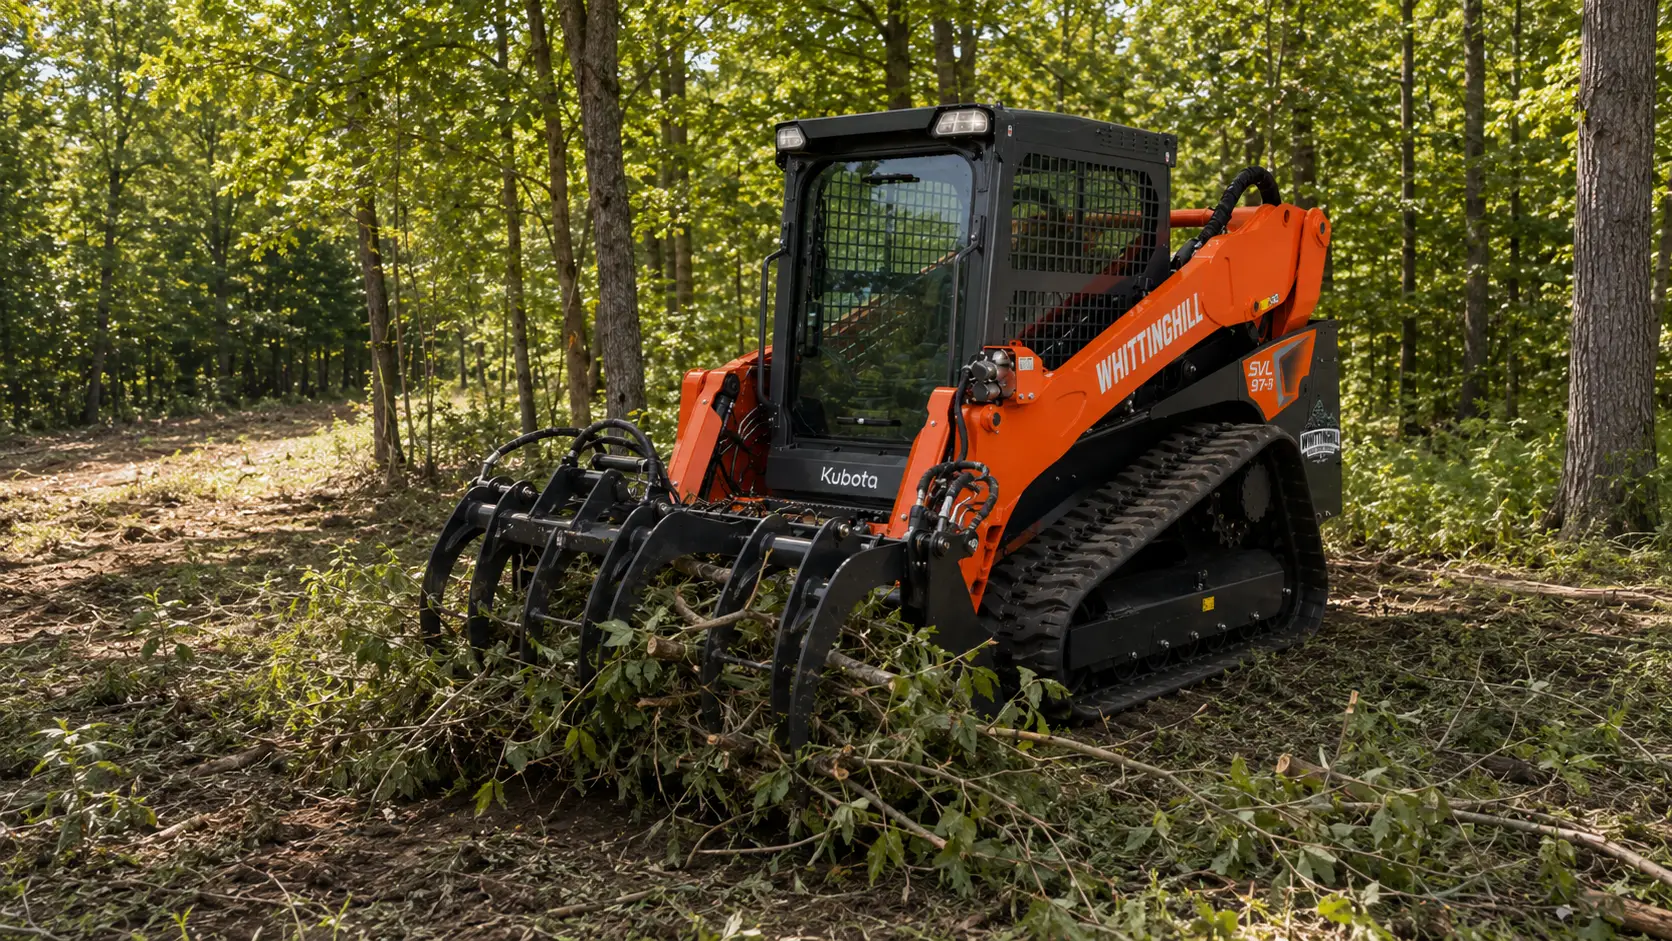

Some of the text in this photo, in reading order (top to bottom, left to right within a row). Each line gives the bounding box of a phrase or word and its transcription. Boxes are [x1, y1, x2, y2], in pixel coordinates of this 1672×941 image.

[1096, 292, 1204, 395] WHITTINGHILL
[1248, 360, 1273, 377] SVL
[820, 466, 878, 489] Kubota
